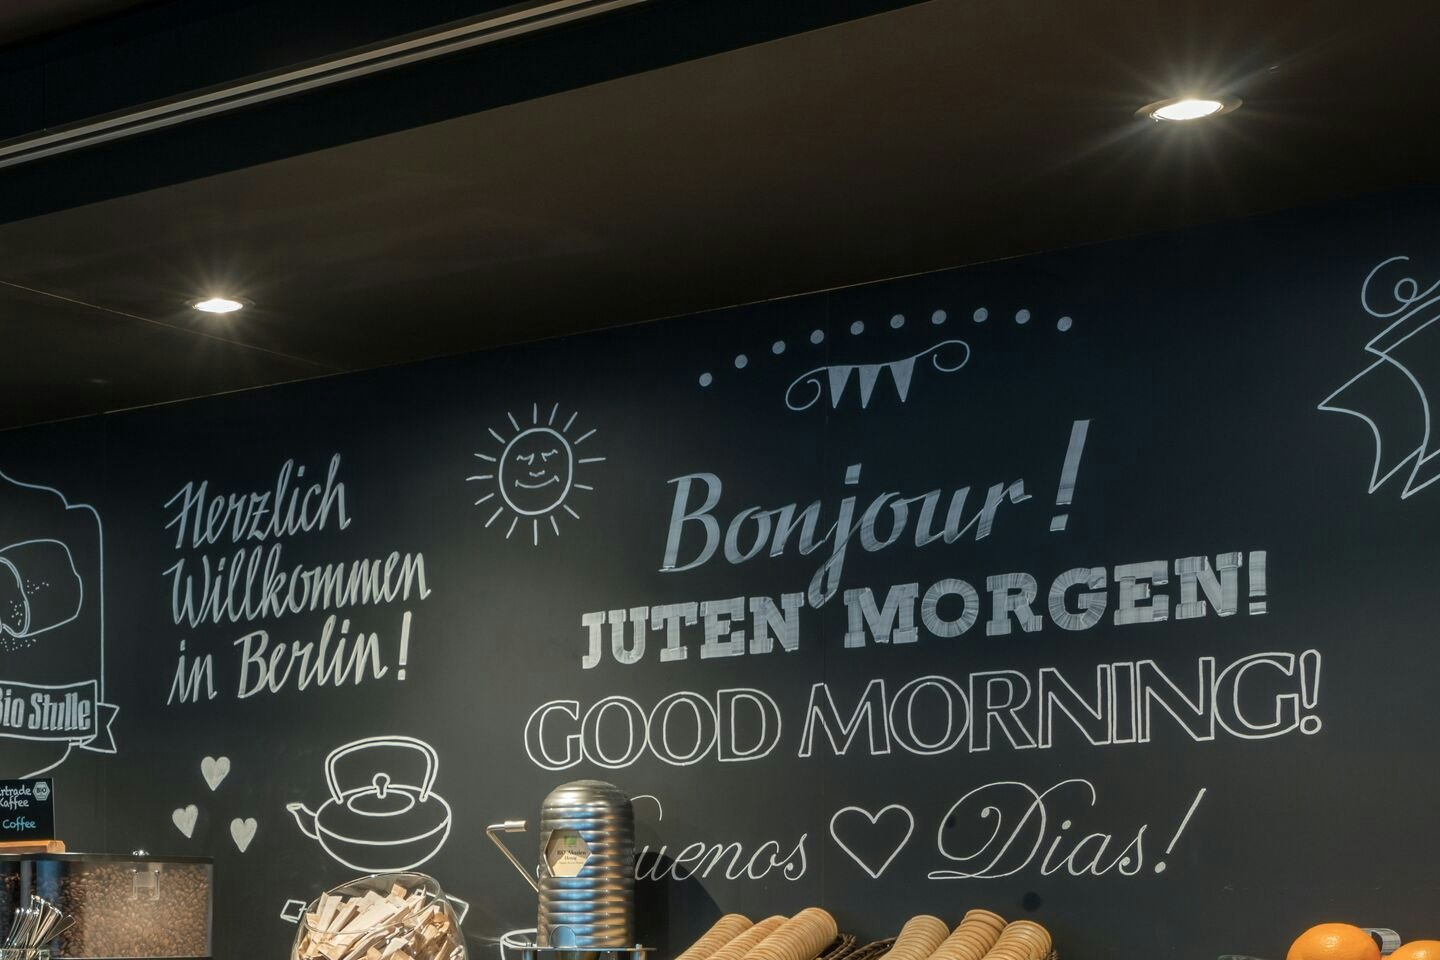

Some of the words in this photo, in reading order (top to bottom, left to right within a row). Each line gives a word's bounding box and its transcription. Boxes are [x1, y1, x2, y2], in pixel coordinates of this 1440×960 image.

[164, 452, 352, 549] Herzlich
[658, 419, 1092, 609] Bonjour!
[162, 542, 432, 629] Willkommen
[581, 591, 806, 670] JUTEN
[843, 549, 1268, 650] MORGEN!
[167, 640, 218, 706] in
[233, 611, 413, 699] Berlin!
[26, 691, 93, 731] Stulle
[524, 687, 782, 772] GOOD
[797, 648, 1323, 759] MORNING!
[2, 816, 37, 831] Coffee
[630, 794, 808, 882] uenos
[927, 777, 1208, 882] Dias!
